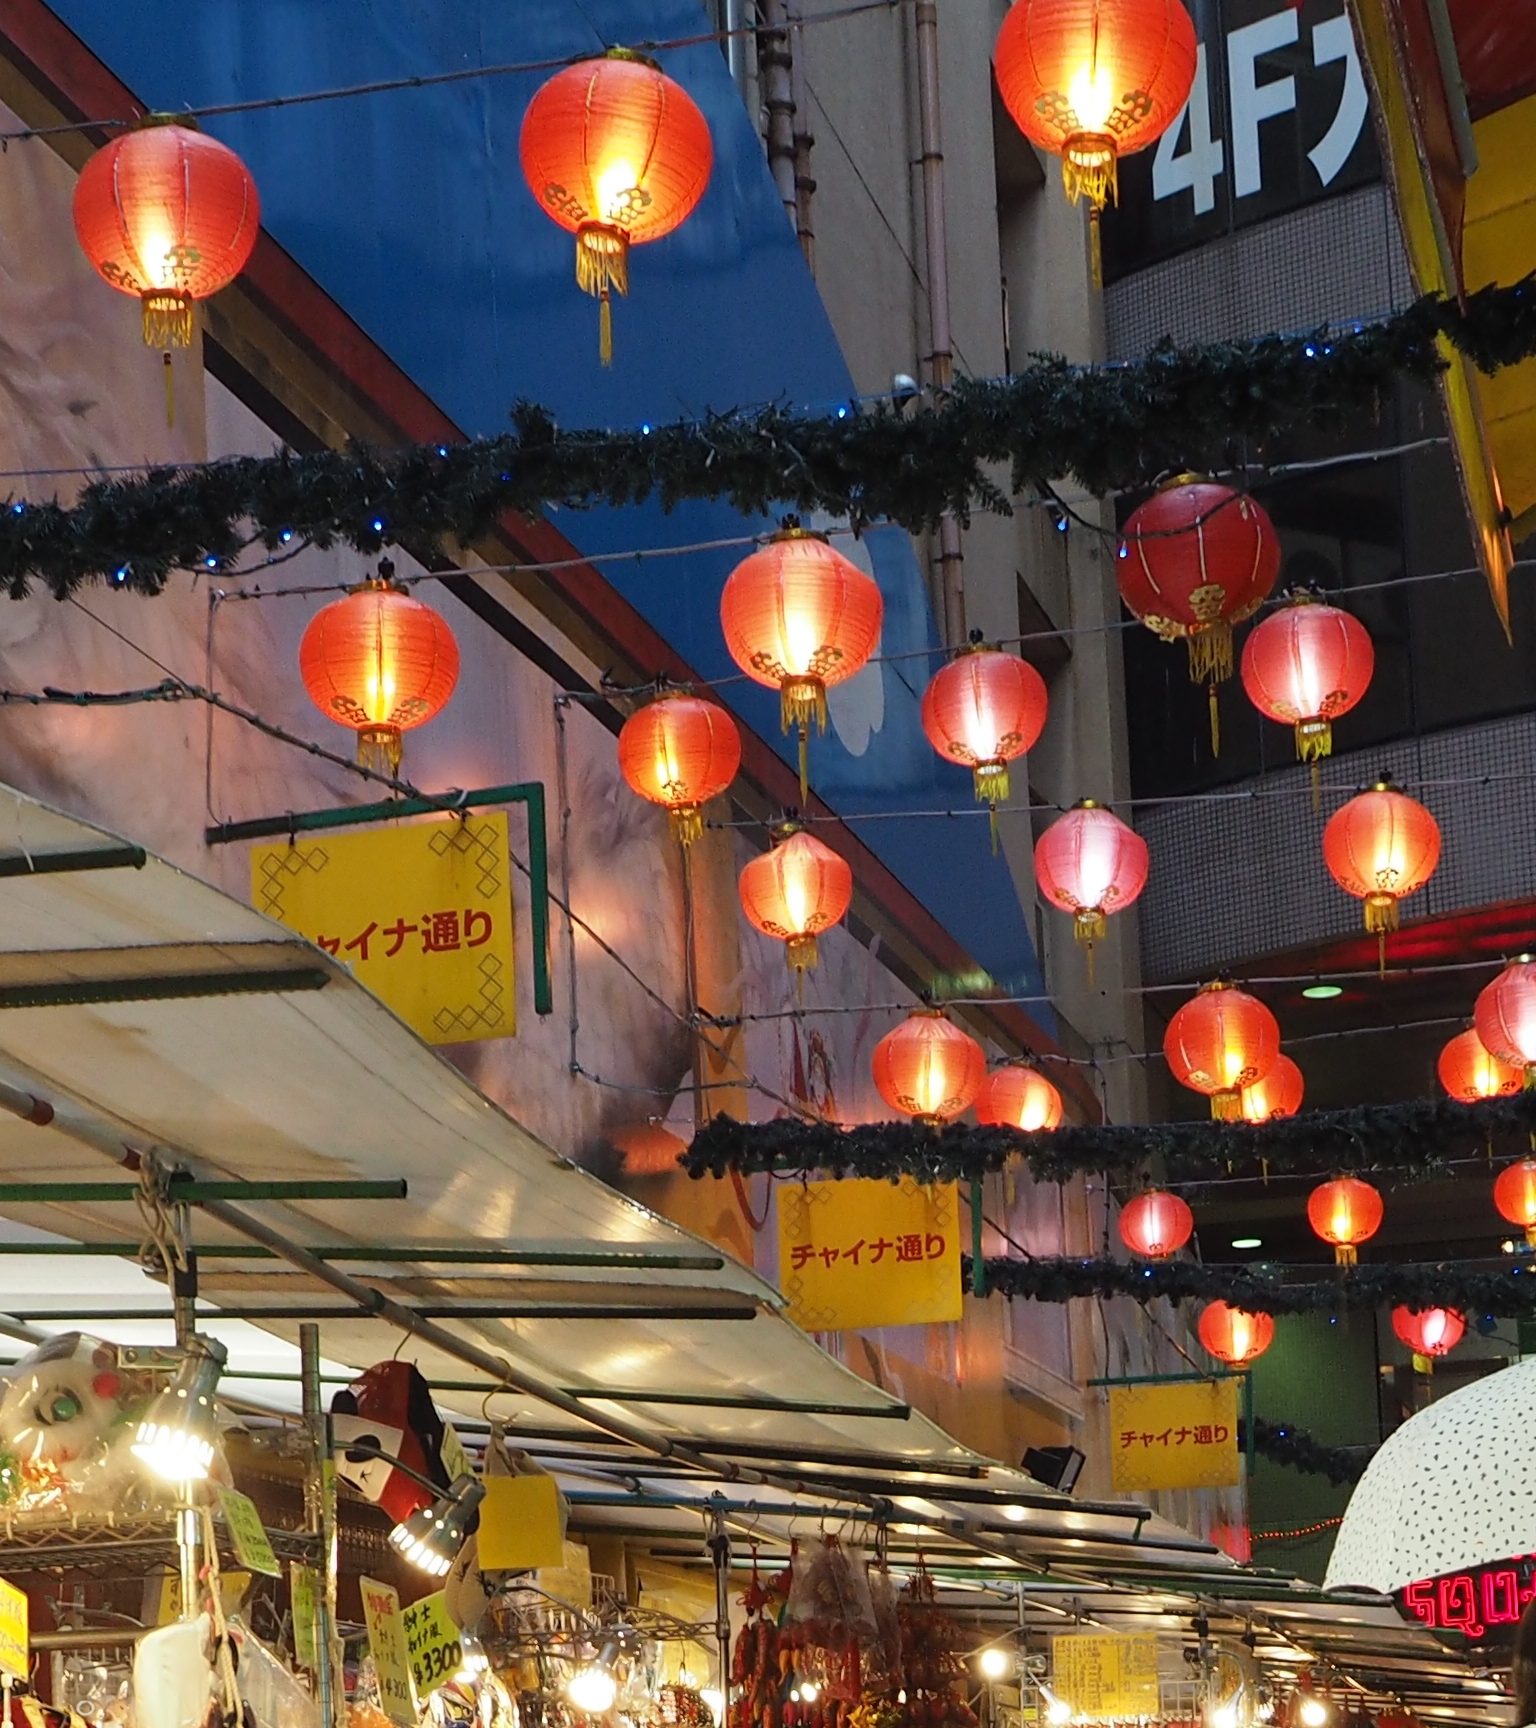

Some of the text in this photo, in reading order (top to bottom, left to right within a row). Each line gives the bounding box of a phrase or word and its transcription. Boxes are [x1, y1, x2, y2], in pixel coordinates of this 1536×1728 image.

[316, 908, 494, 961] ャイナ通り
[790, 1232, 946, 1270] チャイナ通り
[1120, 1424, 1229, 1448] チャイナ通り
